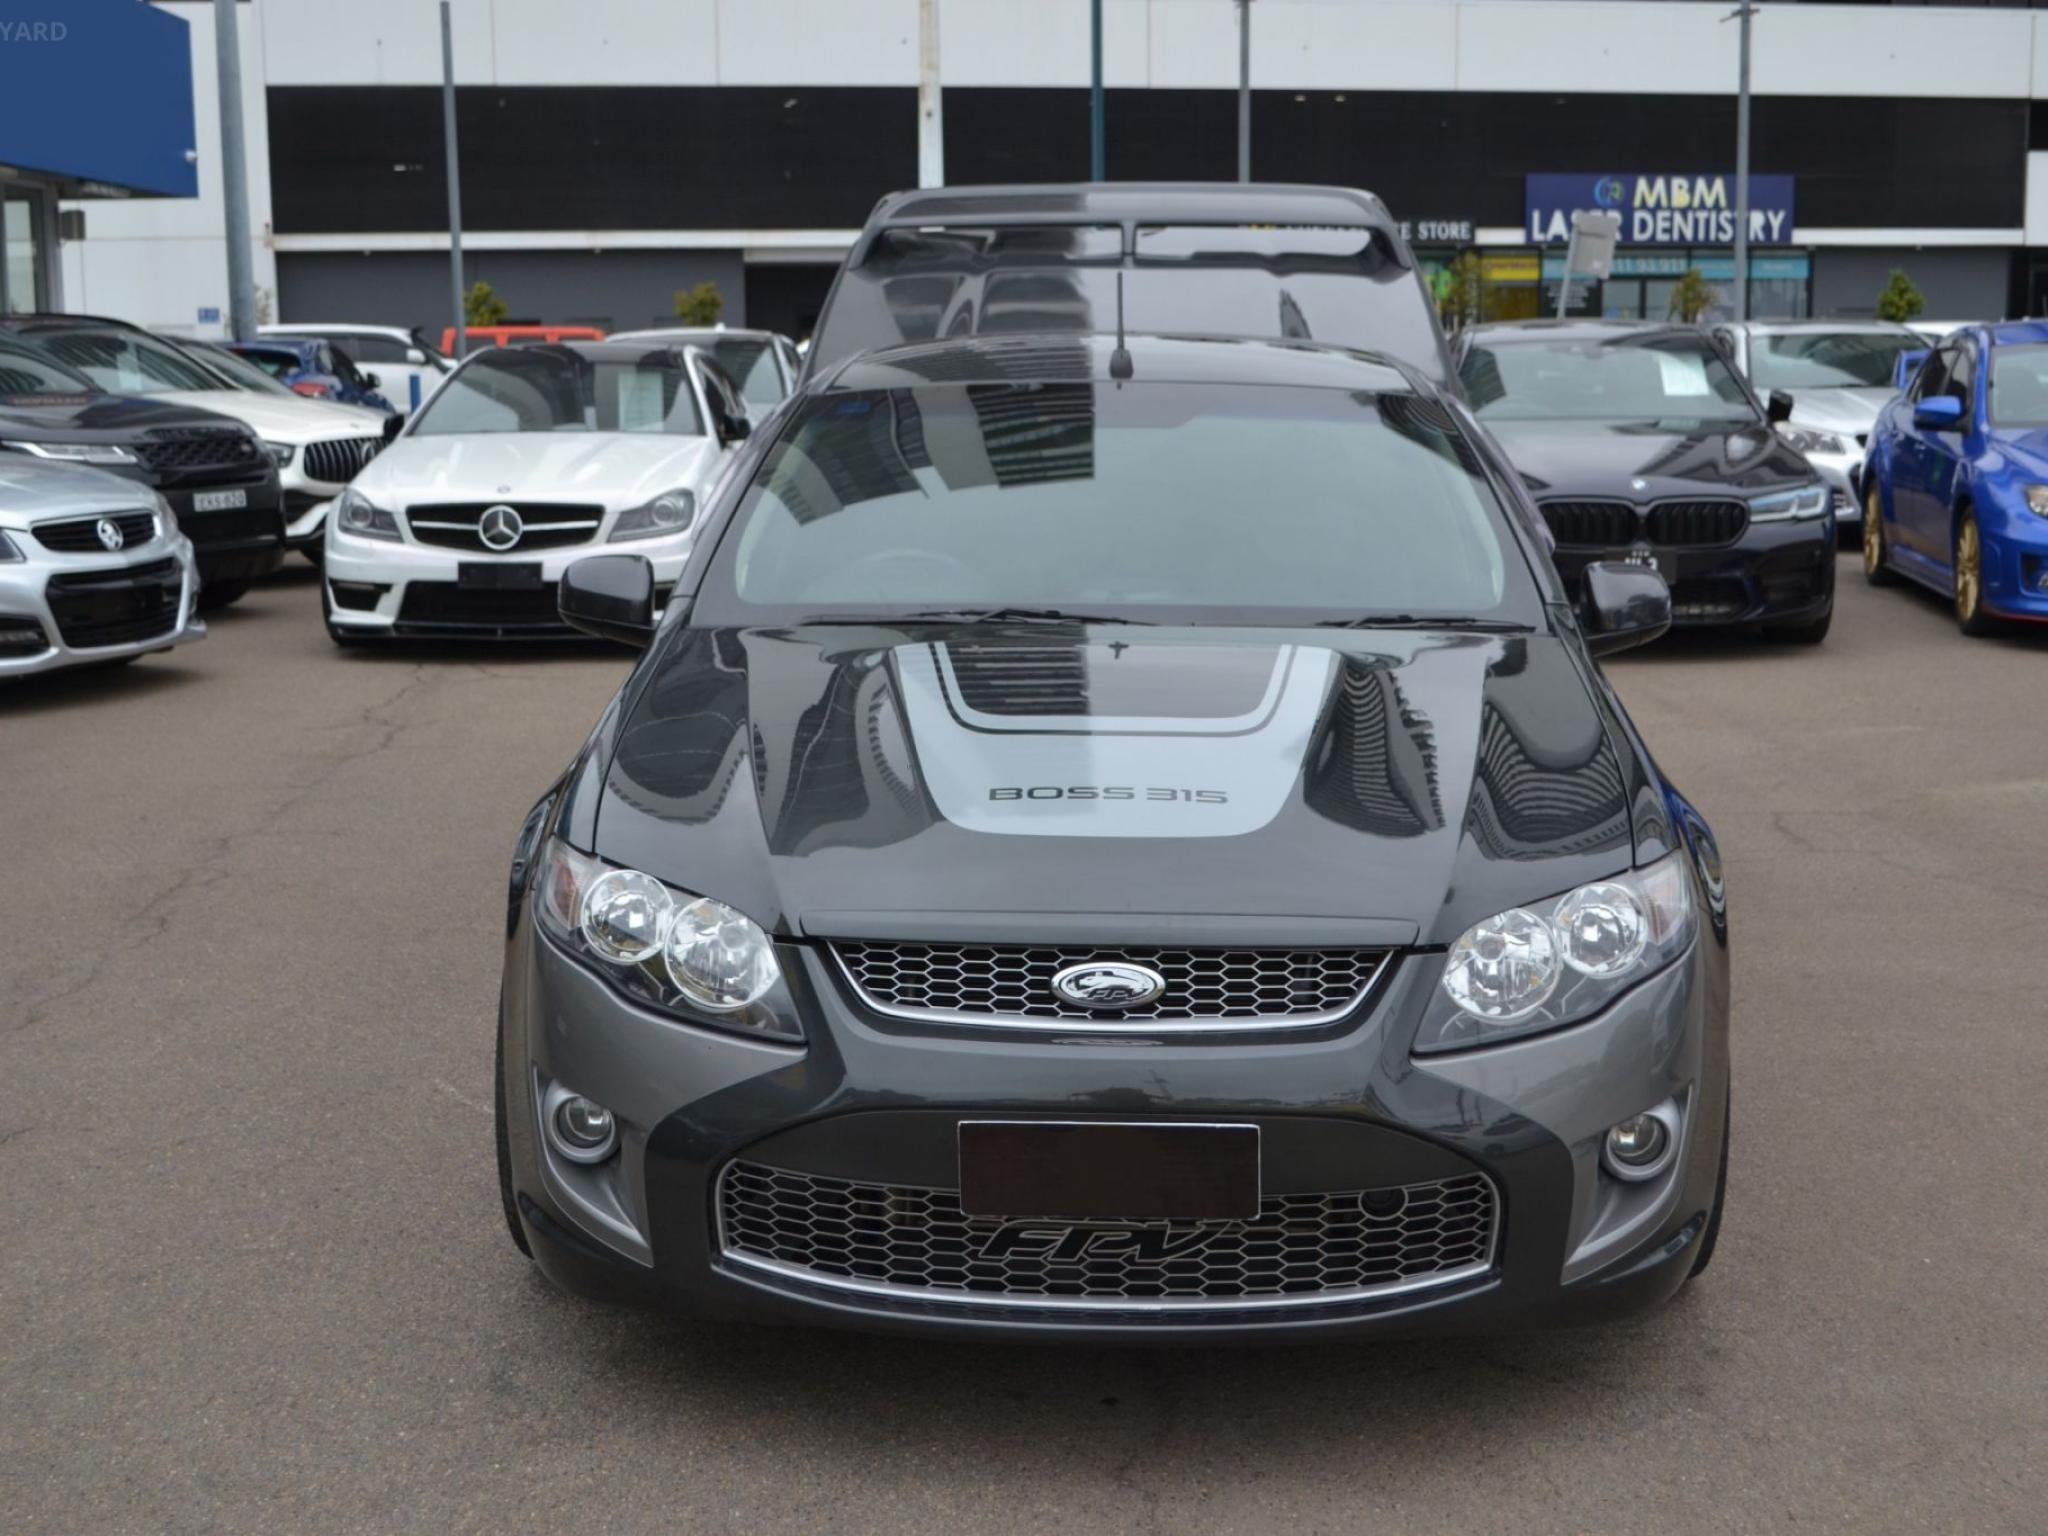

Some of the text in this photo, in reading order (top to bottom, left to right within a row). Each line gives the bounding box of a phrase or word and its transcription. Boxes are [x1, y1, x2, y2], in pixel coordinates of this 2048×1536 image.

[1633, 176, 1728, 209] MBM
[1418, 221, 1472, 240] STORE
[1633, 210, 1786, 242] DENTISRY
[989, 786, 1229, 804] BOSS 315
[977, 1217, 1235, 1263] FPV
